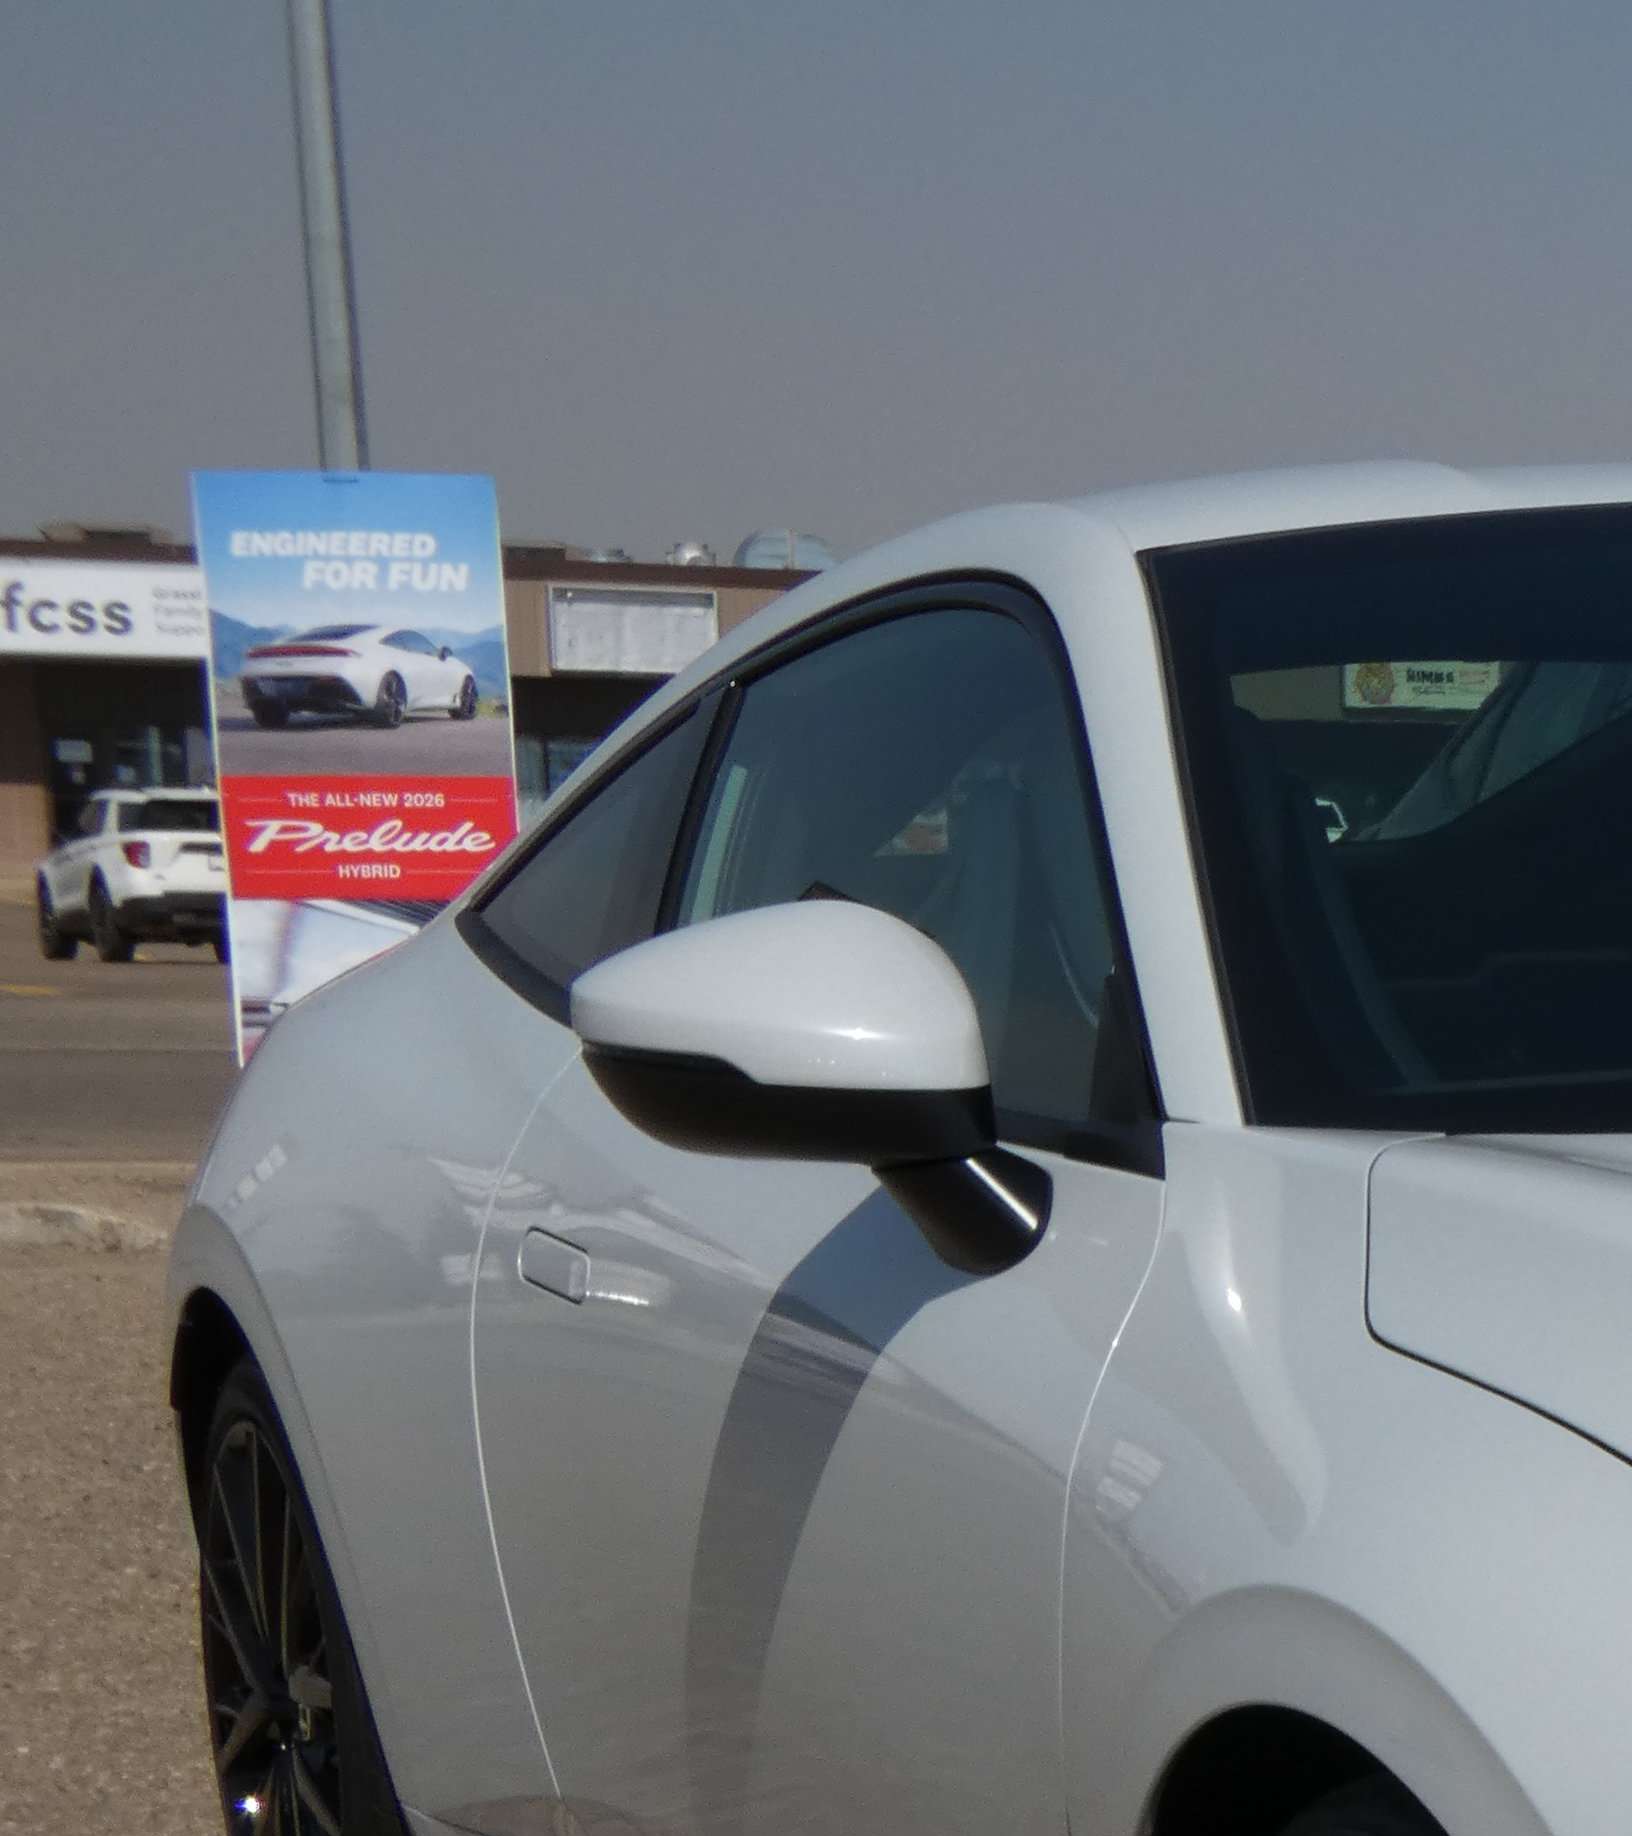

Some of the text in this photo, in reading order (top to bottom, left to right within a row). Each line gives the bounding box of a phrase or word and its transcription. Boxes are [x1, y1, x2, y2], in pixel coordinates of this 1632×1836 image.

[231, 530, 437, 557] ENGINEERED
[302, 560, 470, 592] FOR FUN
[0, 580, 134, 637] fcss
[287, 792, 445, 808] THE ALL-NEW 2026
[245, 818, 496, 853] Prelude
[338, 864, 401, 879] HYBRID
